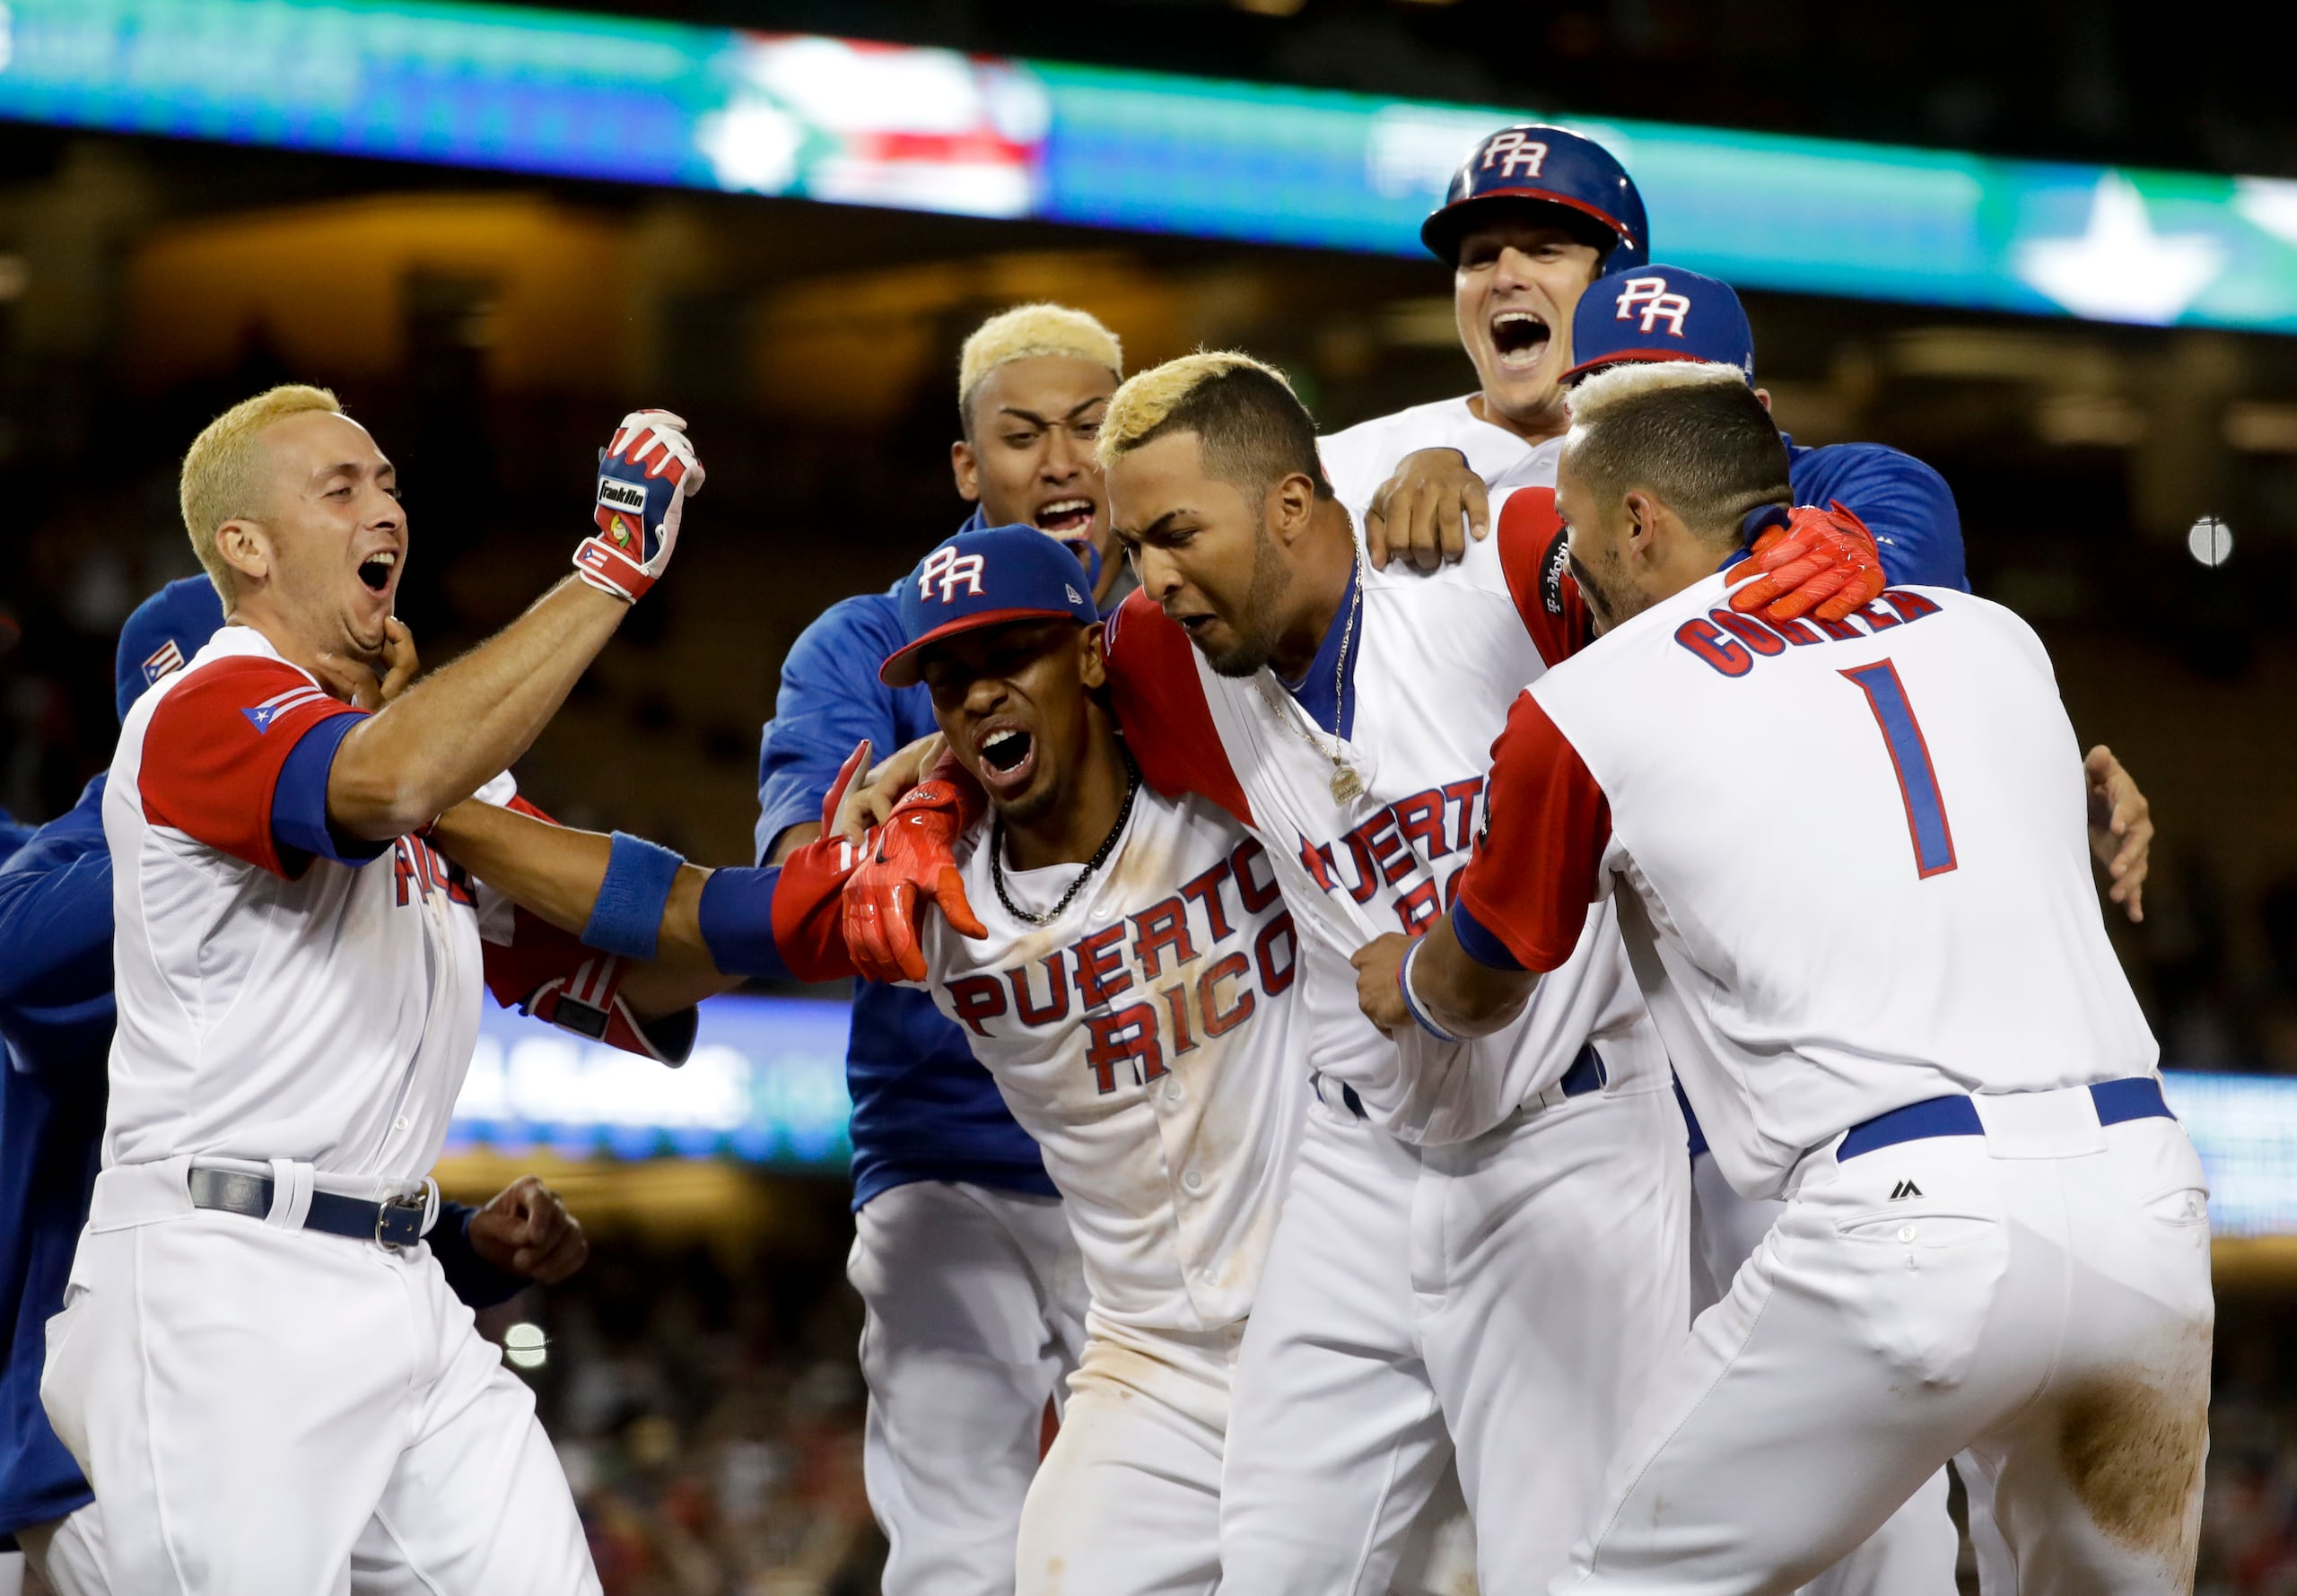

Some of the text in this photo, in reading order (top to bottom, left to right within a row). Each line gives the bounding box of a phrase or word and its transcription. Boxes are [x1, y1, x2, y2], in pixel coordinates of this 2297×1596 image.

[1480, 131, 1550, 179] PR
[1614, 276, 1691, 339] PR
[918, 545, 988, 606] PR
[1546, 541, 1568, 614] T-Mobil
[1835, 657, 1958, 881] 1
[943, 836, 1285, 1039] PUERTO
[1081, 909, 1297, 1095] RICO
